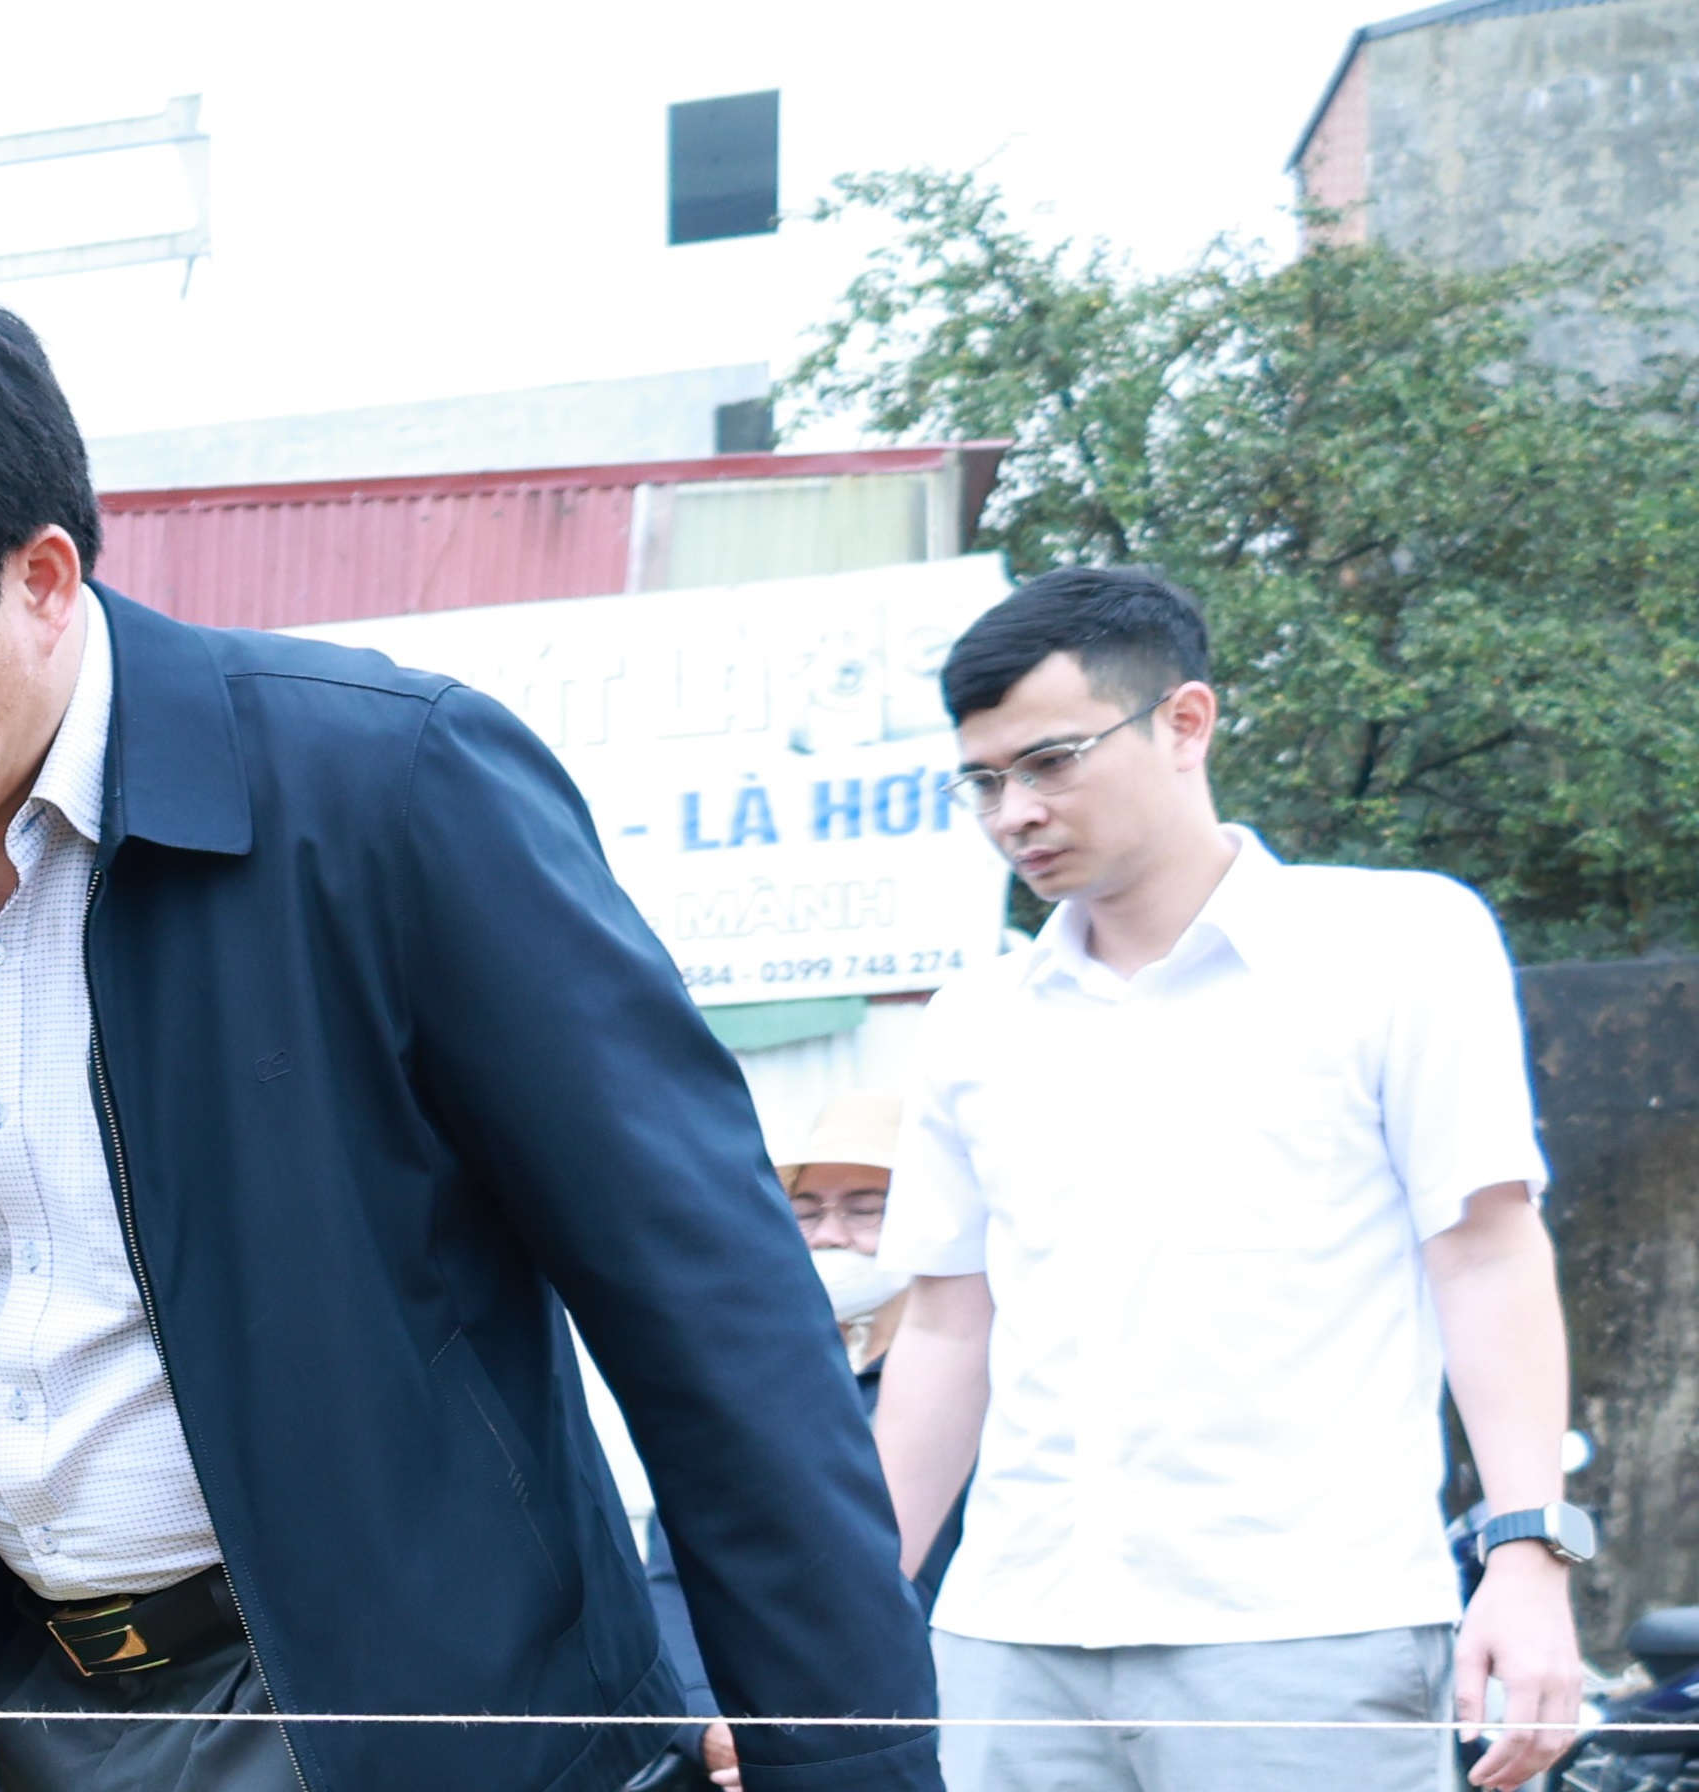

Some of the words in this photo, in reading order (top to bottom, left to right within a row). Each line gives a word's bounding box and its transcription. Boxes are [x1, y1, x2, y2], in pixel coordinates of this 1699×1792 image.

[681, 771, 780, 852] LÀ
[760, 956, 833, 985] 0399
[847, 952, 897, 979] 748
[910, 949, 965, 975] 274
